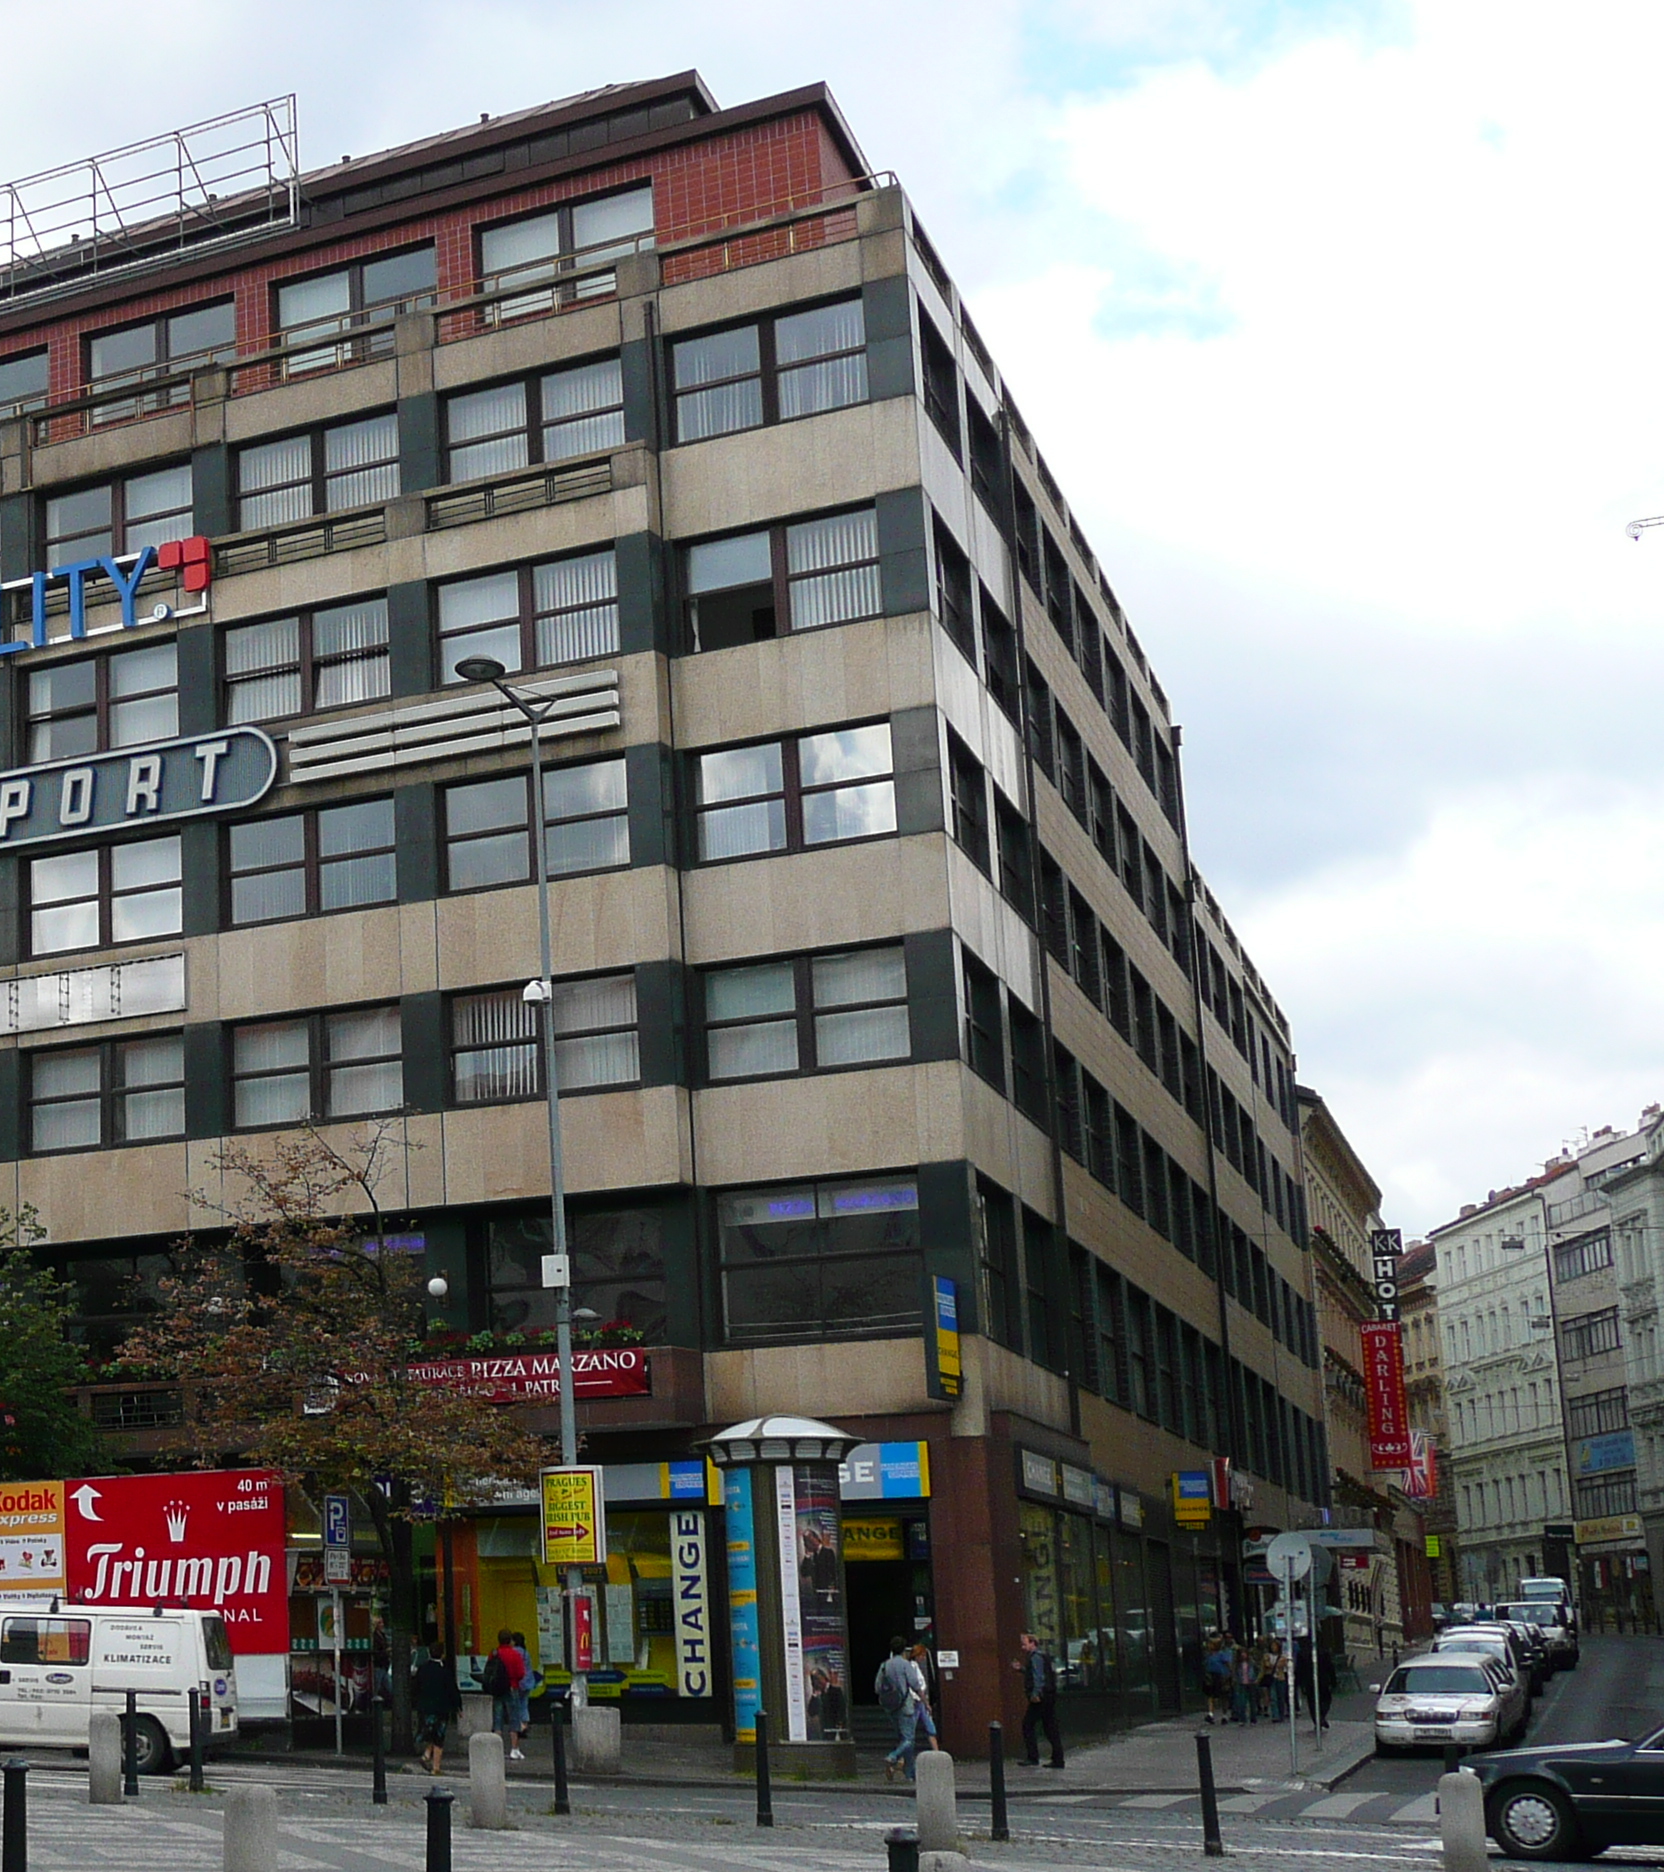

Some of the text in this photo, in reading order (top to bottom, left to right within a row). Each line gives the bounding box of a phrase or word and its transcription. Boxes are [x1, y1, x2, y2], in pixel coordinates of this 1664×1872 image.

[1377, 1261, 1396, 1320] HOT
[1361, 1322, 1397, 1335] CABARET
[471, 1358, 528, 1379] PIZZA
[1374, 1335, 1396, 1435] DARLING
[237, 1479, 268, 1491] 40 m
[216, 1496, 268, 1514] v pasáži
[548, 1501, 586, 1512] BIGGEST
[546, 1512, 591, 1522] IRISH PUB
[842, 1526, 898, 1541] ANGE
[84, 1542, 271, 1605] Triumph
[677, 1514, 706, 1696] CHANGE
[103, 1654, 172, 1665] KLIMATIZACE
